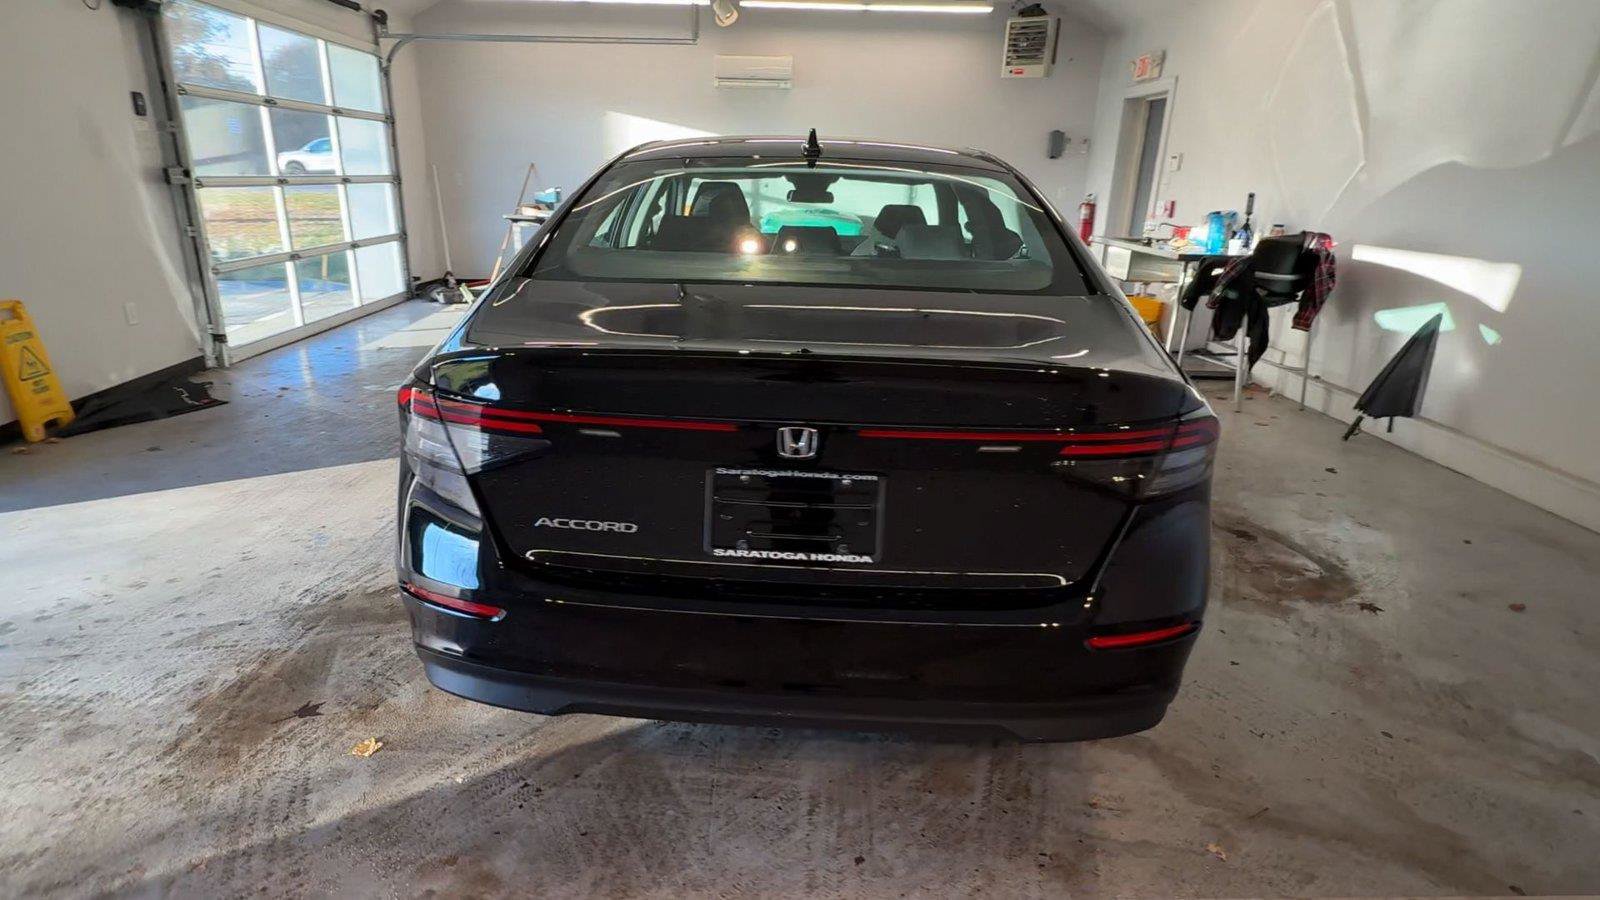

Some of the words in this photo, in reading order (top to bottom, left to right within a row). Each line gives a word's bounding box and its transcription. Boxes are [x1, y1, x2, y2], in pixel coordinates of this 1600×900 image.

[534, 517, 638, 533] ACCORD
[713, 548, 808, 561] SARATOGA
[810, 553, 874, 564] HONDA
